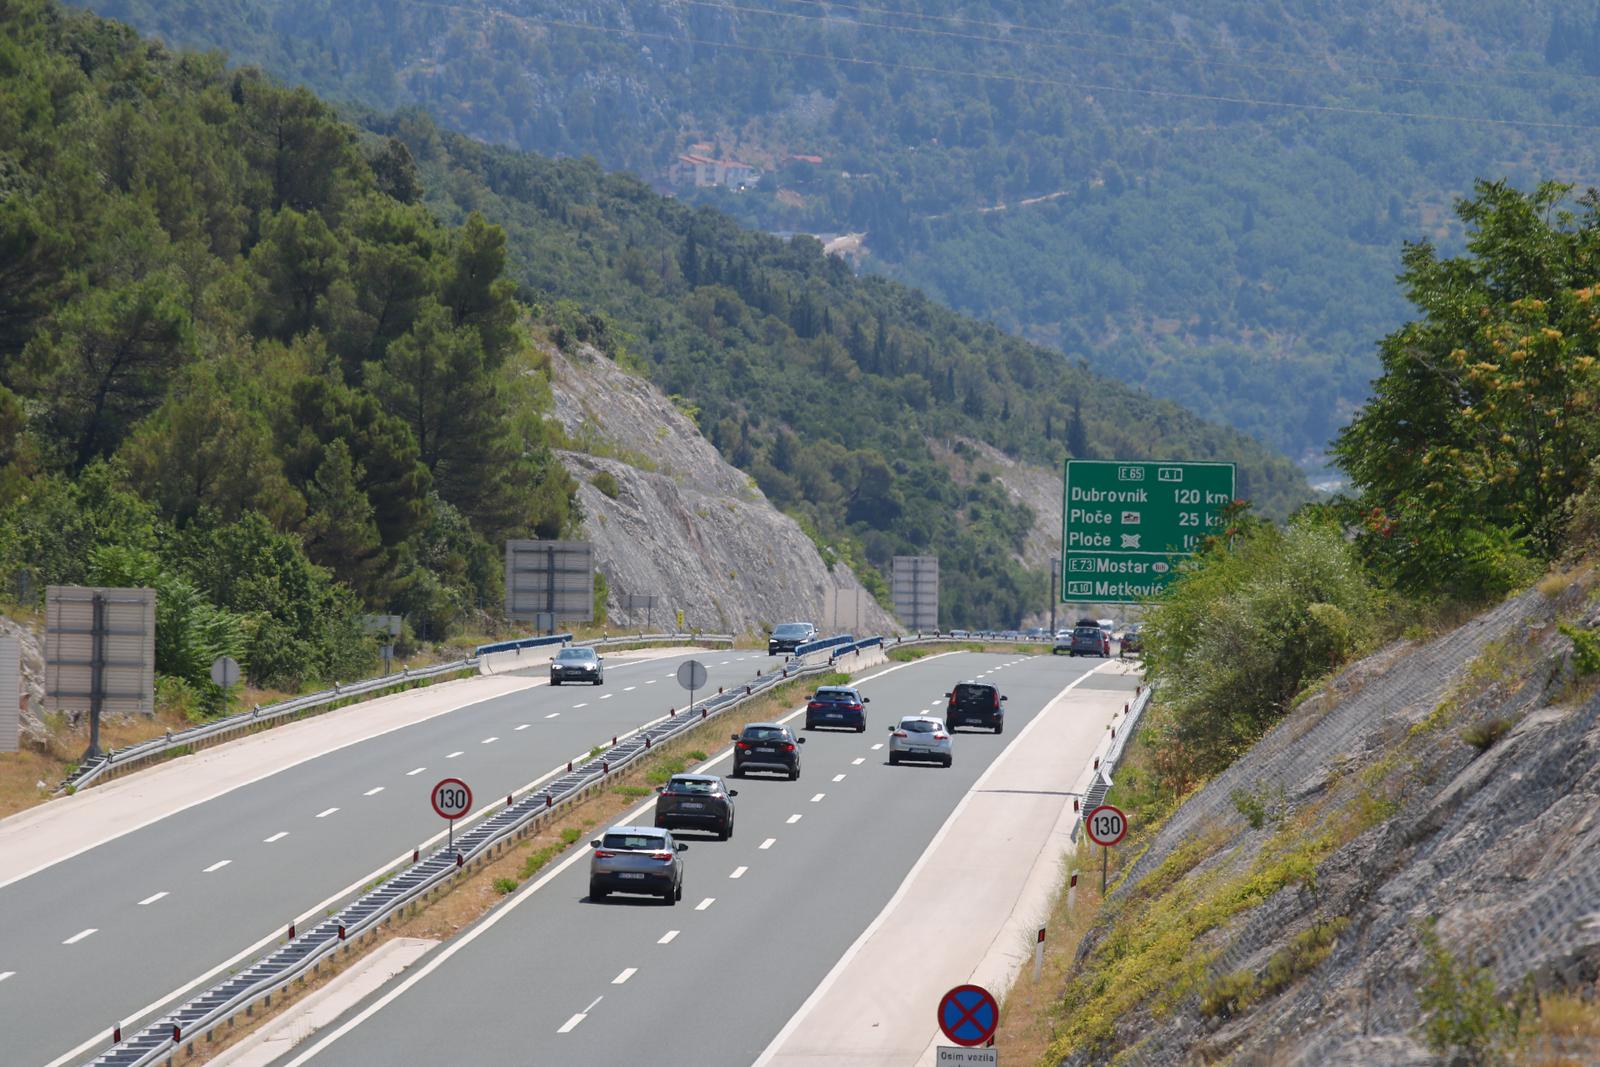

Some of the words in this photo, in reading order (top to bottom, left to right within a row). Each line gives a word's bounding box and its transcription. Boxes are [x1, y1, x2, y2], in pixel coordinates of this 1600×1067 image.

[1121, 468, 1127, 478] E
[1129, 468, 1142, 479] 65
[1164, 470, 1170, 479] A
[1071, 487, 1148, 502] Dubrovnik
[1174, 489, 1200, 504] 120
[1206, 490, 1229, 504] km
[1070, 509, 1112, 524] Ploče
[1179, 512, 1200, 526] 25
[1069, 532, 1111, 547] Ploče
[1071, 560, 1077, 570] E
[1080, 560, 1093, 571] 73
[1096, 558, 1150, 573] Mostar
[1080, 583, 1089, 592] 10
[1095, 581, 1163, 597] Metković
[440, 789, 465, 808] 130
[1094, 816, 1120, 835] 130
[941, 1051, 964, 1061] Osim
[967, 1053, 994, 1062] vozila
